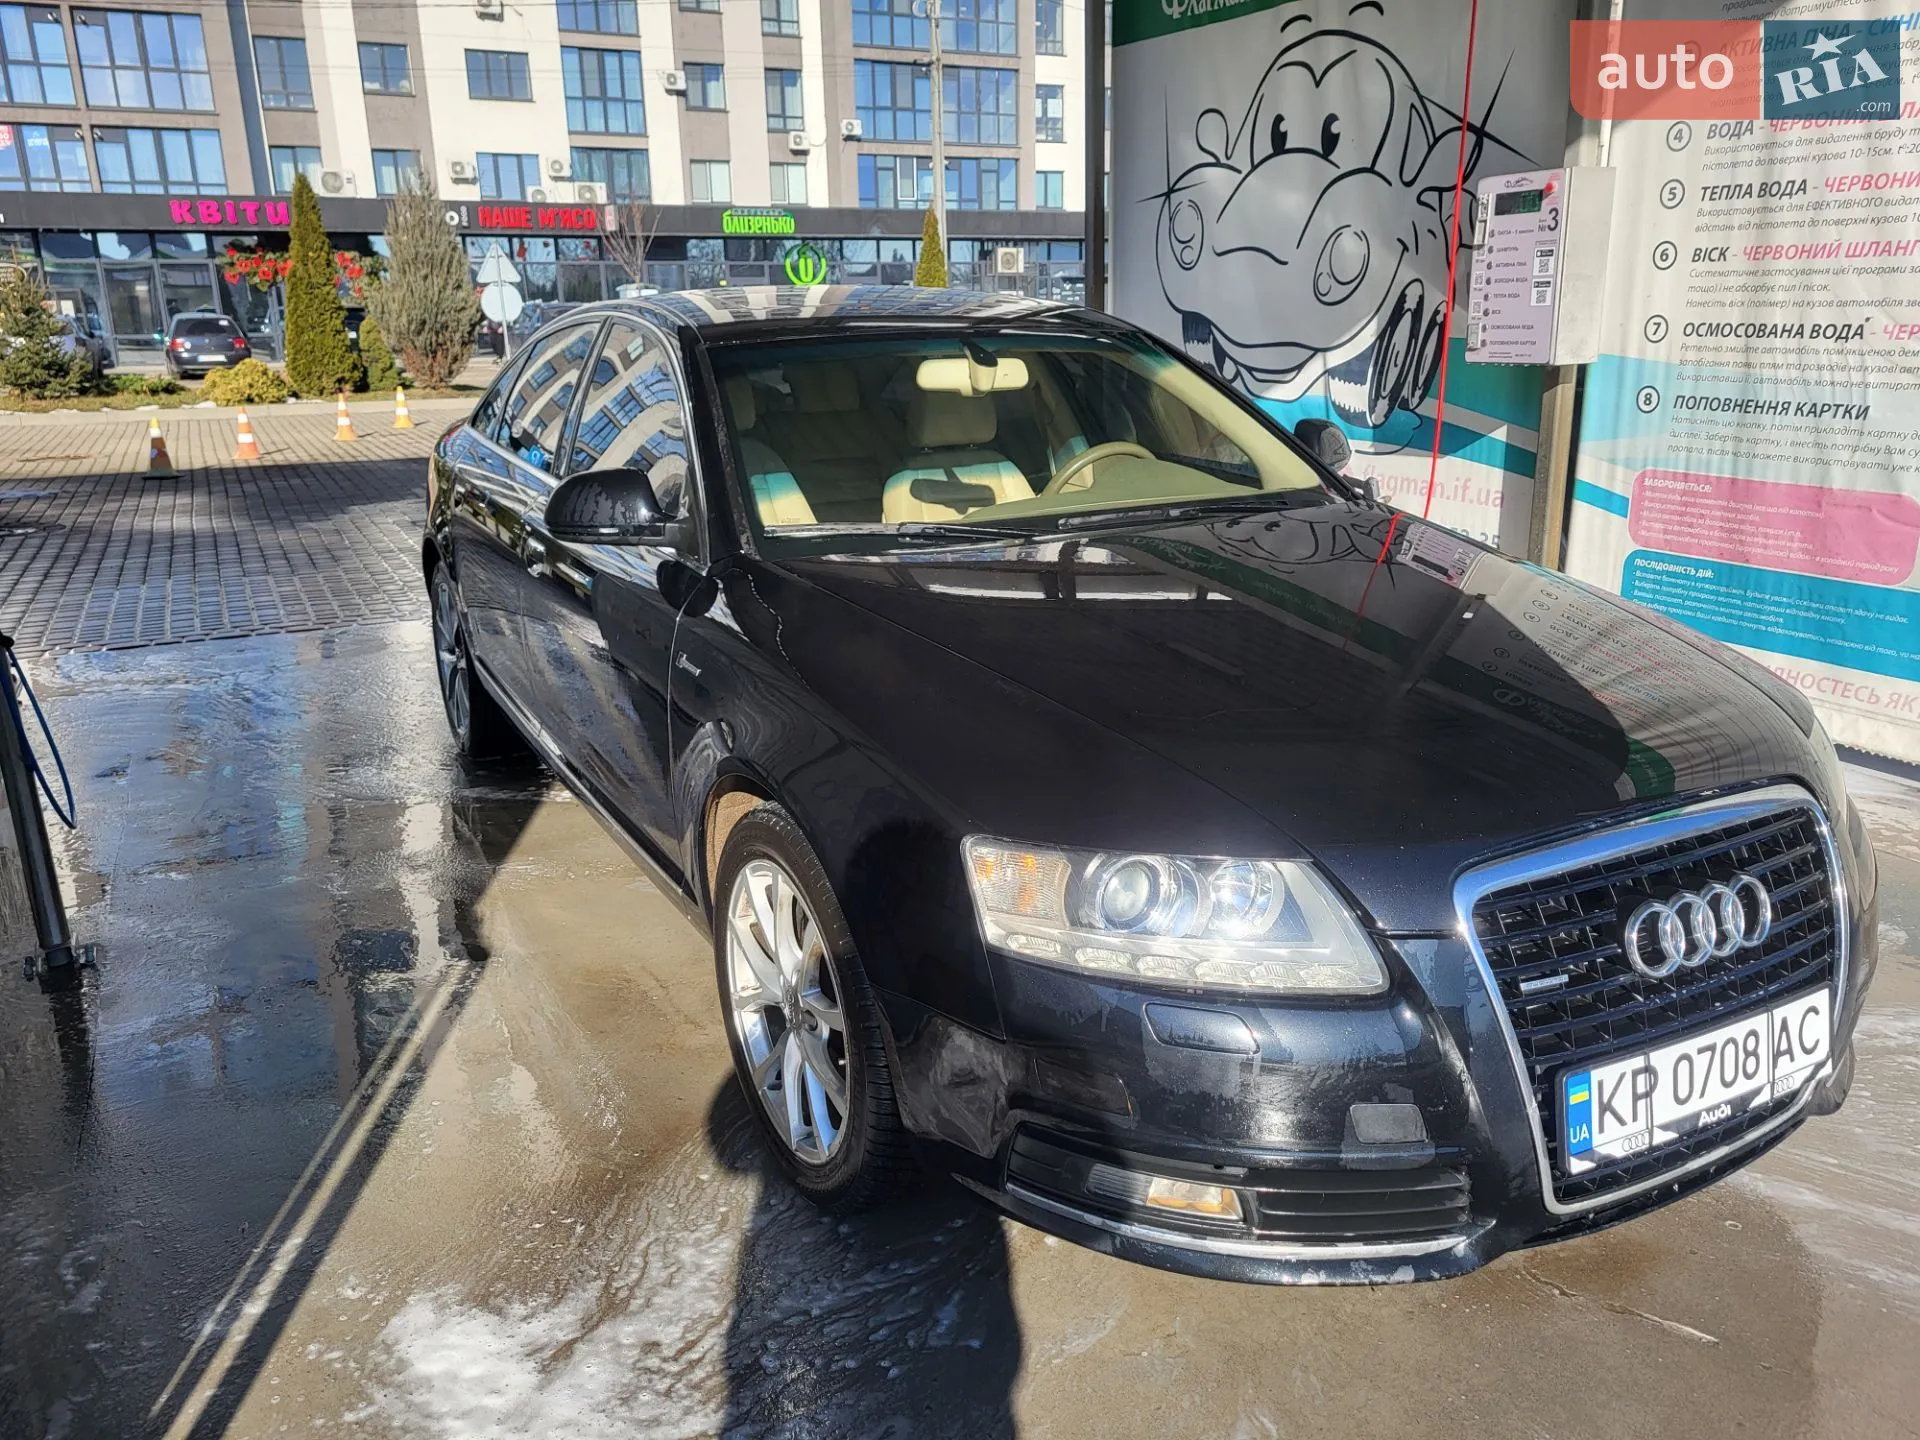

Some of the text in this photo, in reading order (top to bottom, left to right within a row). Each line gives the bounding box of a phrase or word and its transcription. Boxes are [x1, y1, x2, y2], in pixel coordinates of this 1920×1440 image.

[1704, 126, 1907, 156] Використовується для видалення бруду
[1706, 120, 1754, 141] ВОДА
[1702, 157, 1753, 171] пістолета
[1754, 156, 1767, 168] до
[1767, 154, 1811, 168] поверхні
[1811, 151, 1846, 164] кузова
[1700, 183, 1753, 202] ТЕПЛА
[1757, 178, 1808, 199] ВОДА
[477, 204, 534, 230] НАШЕ
[538, 206, 598, 231] М'ЯСО
[1696, 205, 1784, 218] Використовується
[1786, 203, 1804, 213] для
[1805, 196, 1882, 212] ЕФЕКТИВНОГО
[1547, 207, 1559, 232] 3
[1695, 213, 1909, 233] відстань від пістолета до поверхні кузова
[1691, 246, 1731, 262] ВІСК
[1743, 238, 1842, 261] ЧЕРВОНИЙ
[1689, 267, 1759, 278] Систематичне
[1760, 266, 1831, 279] застосування
[1851, 265, 1908, 278] програми
[1791, 299, 1805, 308] на
[1806, 299, 1835, 310] кузов
[1836, 296, 1904, 308] автомобіля
[1683, 322, 1804, 339] ОСМОСОВАНА
[1809, 323, 1865, 343] ВОДА
[1785, 362, 1802, 371] та
[1813, 378, 1850, 388] можна
[1673, 395, 1792, 417] ПОПОВНЕННЯ
[1794, 401, 1871, 421] КАРТКИ
[1804, 424, 1865, 436] прикладіть
[1866, 429, 1910, 442] картку
[1883, 444, 1906, 456] Вам
[1596, 1004, 1821, 1135] KP 0708 AC
[1698, 1103, 1732, 1128] Audi
[1569, 1122, 1590, 1144] UA
